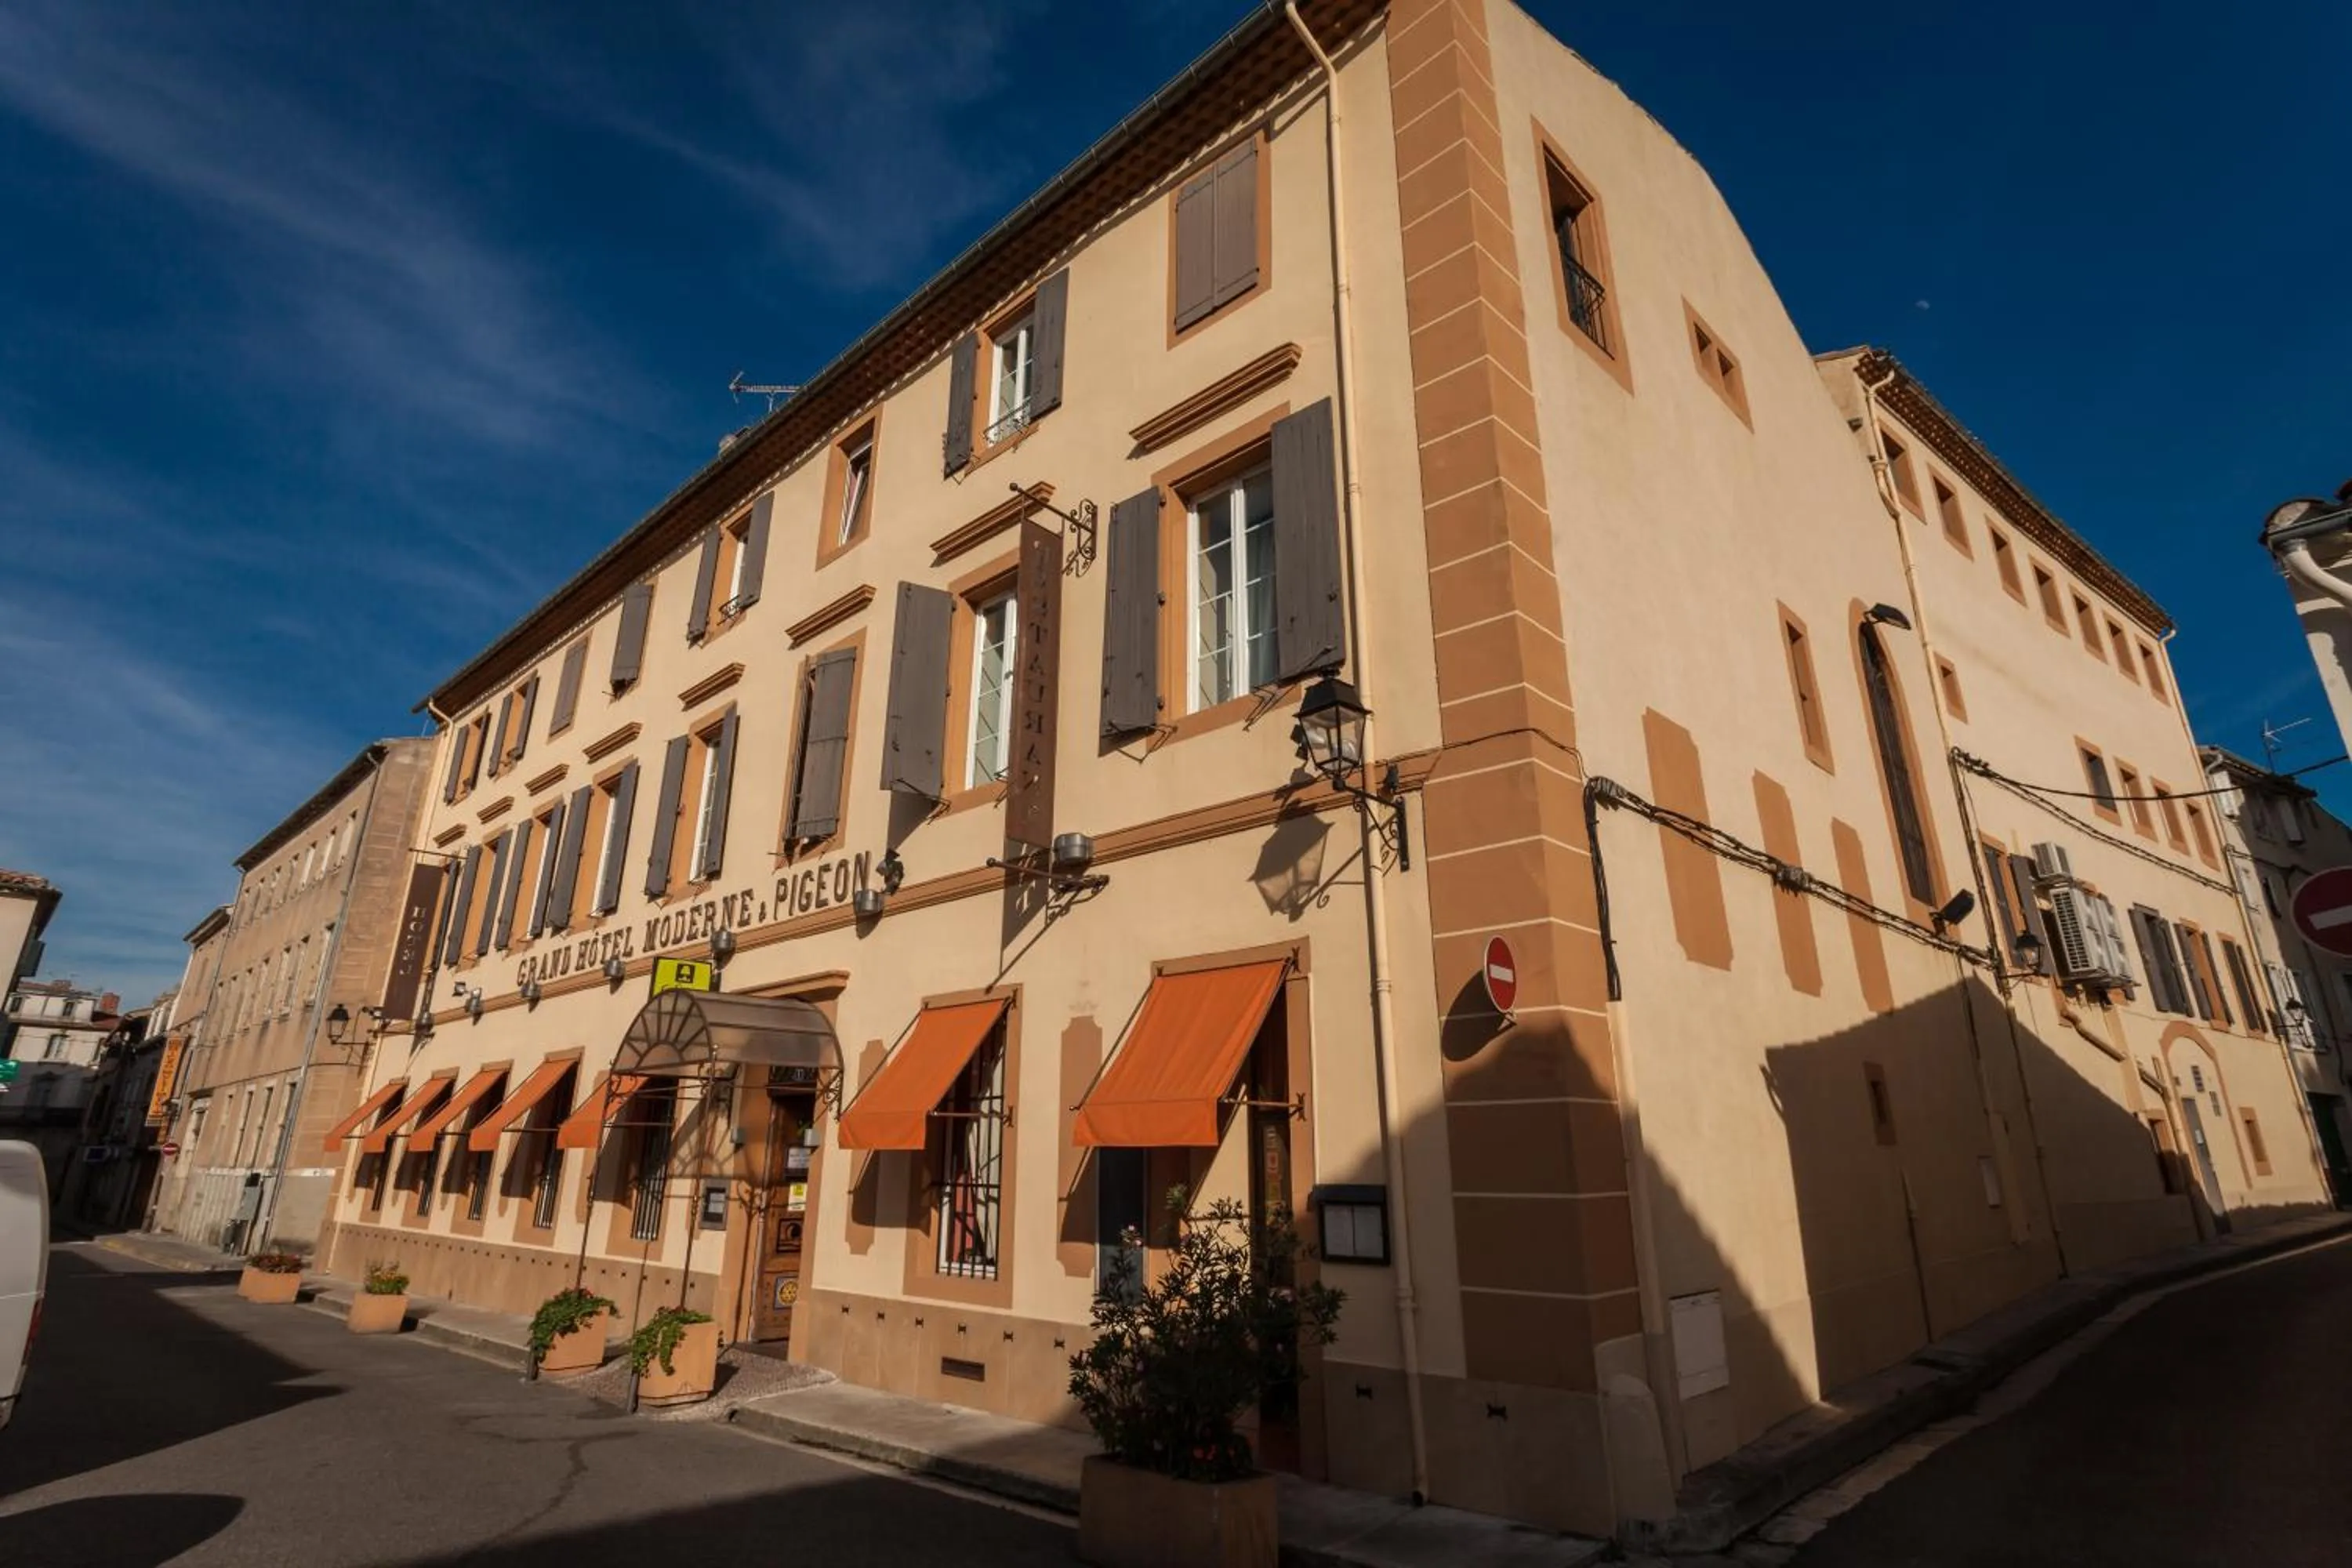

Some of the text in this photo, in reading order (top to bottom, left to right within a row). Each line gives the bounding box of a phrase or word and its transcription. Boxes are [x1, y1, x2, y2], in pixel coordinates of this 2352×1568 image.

[516, 946, 573, 986] GRAND
[575, 925, 634, 972] HÔTEL
[642, 887, 754, 953] MODERNE
[773, 851, 872, 921] PIGEON
